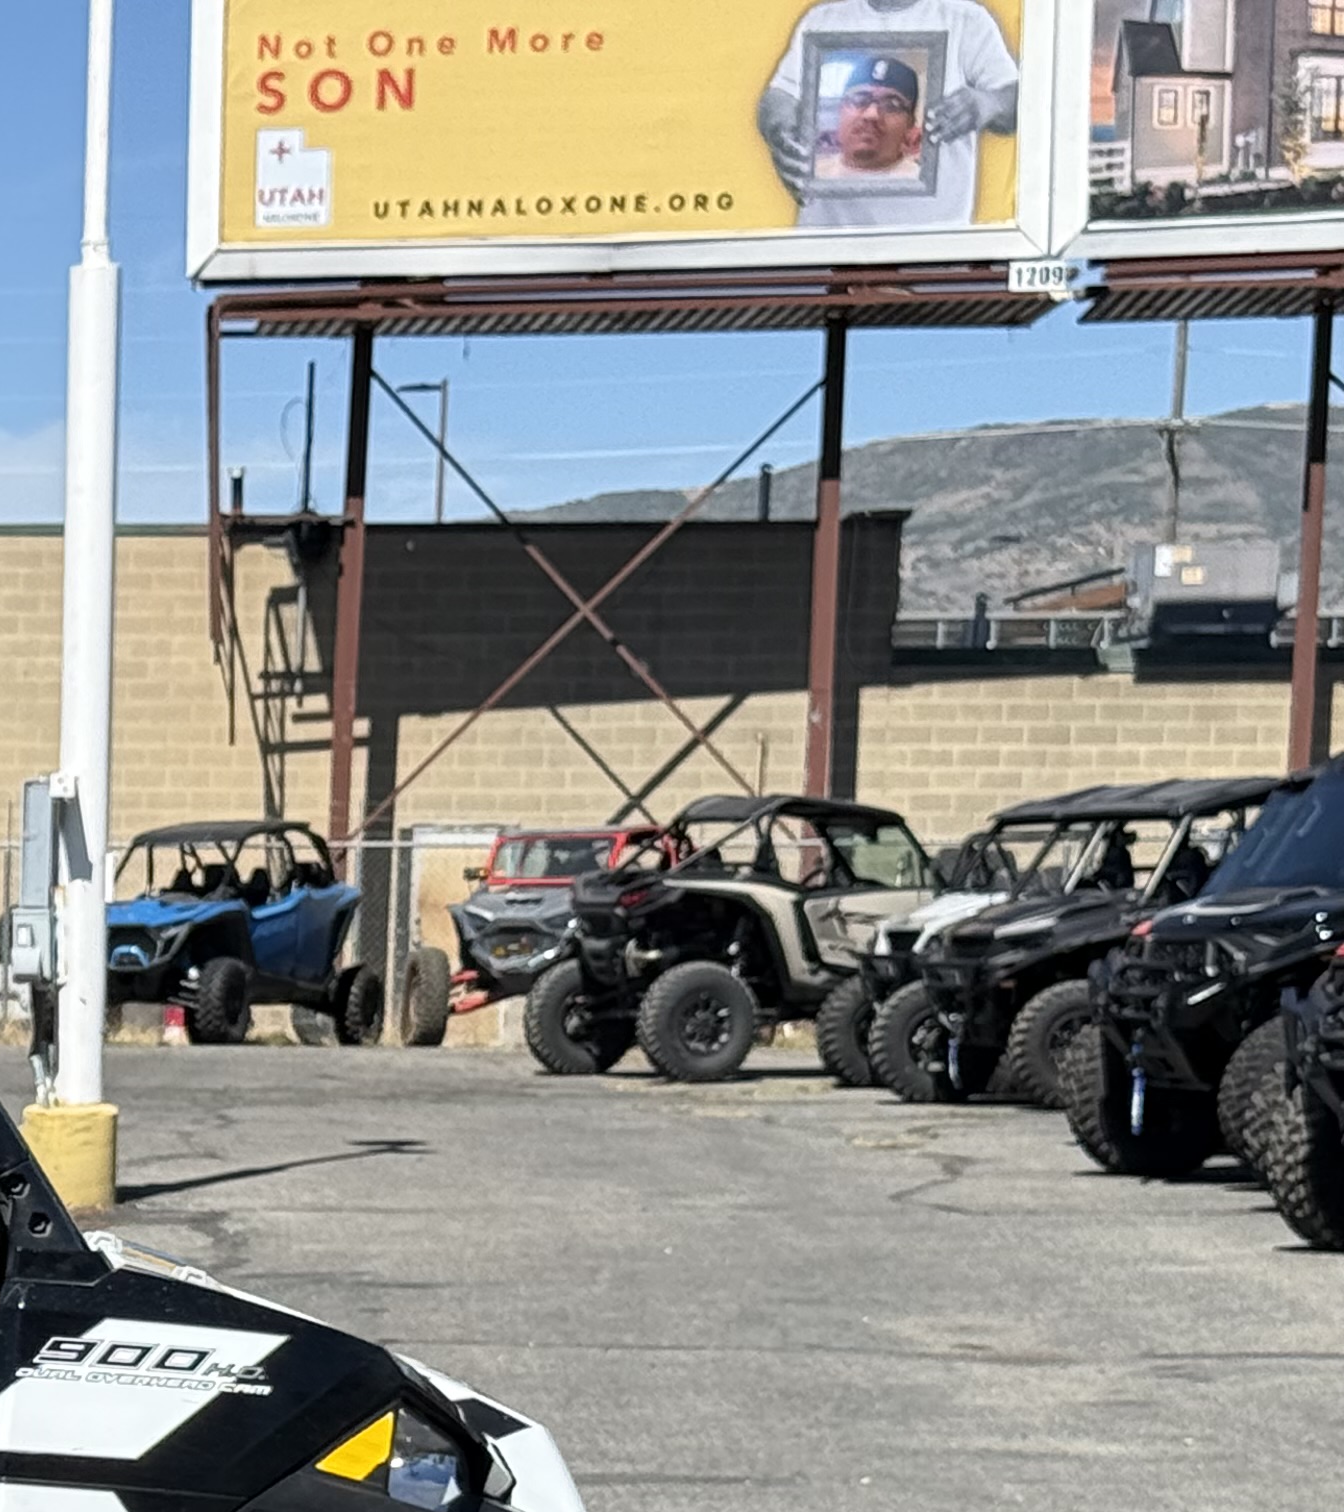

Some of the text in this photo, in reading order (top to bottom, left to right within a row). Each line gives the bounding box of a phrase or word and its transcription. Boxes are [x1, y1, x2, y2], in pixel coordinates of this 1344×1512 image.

[256, 26, 605, 61] Not One More
[256, 68, 416, 114] SON
[258, 187, 324, 206] UTAH
[373, 192, 734, 220] UTAHNALOXONE.ORG
[32, 1337, 216, 1375] 900
[14, 1366, 272, 1396] DUAL OVERHEAD CAM
